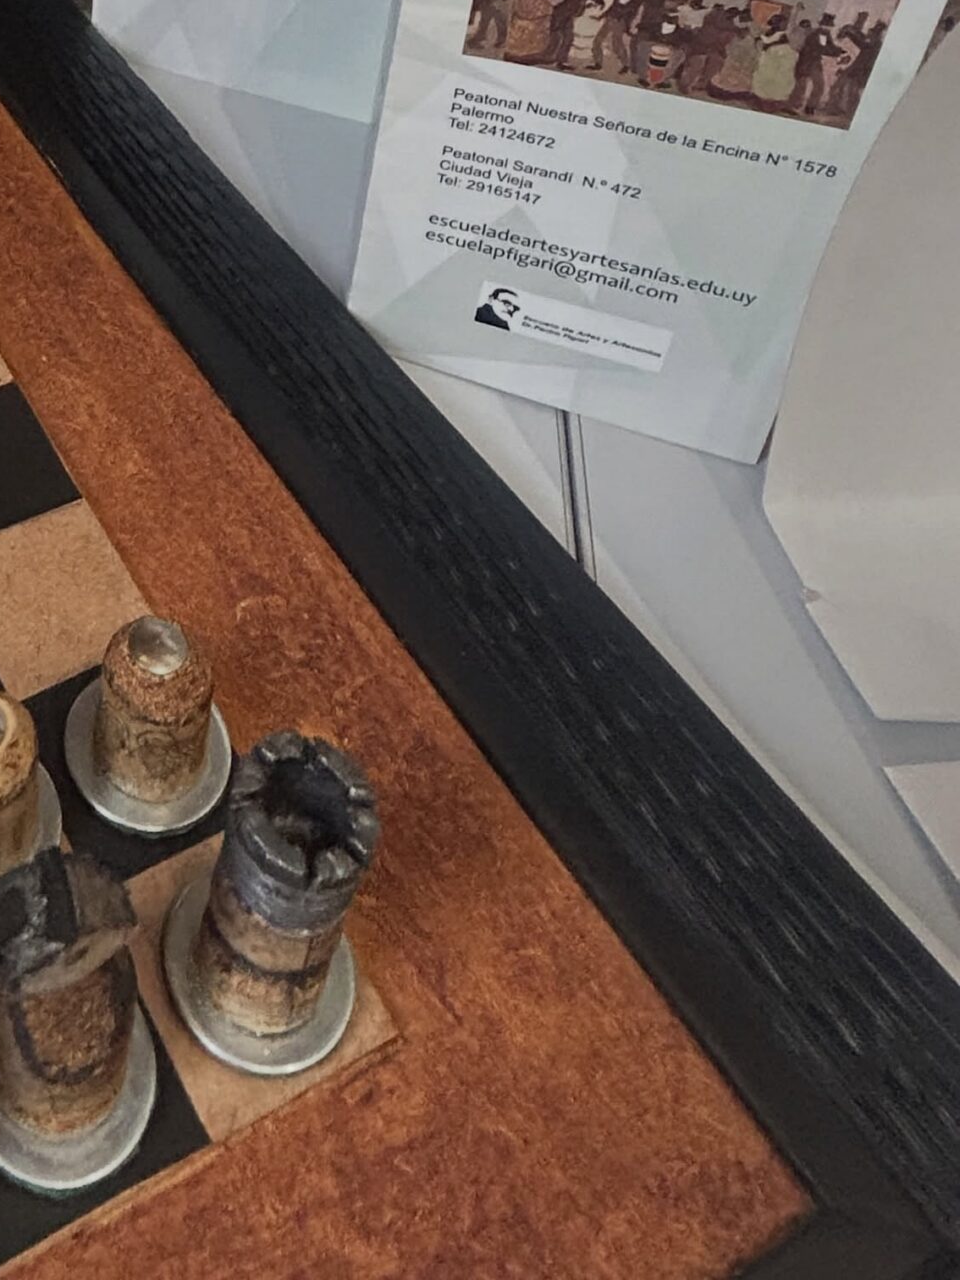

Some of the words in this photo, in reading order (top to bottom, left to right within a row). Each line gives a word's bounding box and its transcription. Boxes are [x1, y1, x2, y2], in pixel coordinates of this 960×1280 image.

[451, 102, 514, 124] Palermo
[449, 117, 473, 131] Tel:
[478, 123, 555, 149] 24124672
[452, 88, 522, 110] Peatonal
[526, 102, 588, 125] Nuestra
[593, 116, 651, 138] Señora
[657, 131, 678, 144] de
[682, 135, 697, 148] la
[702, 139, 760, 161] Encina
[796, 159, 837, 177] 1578
[438, 160, 492, 180] Ciudad
[497, 171, 533, 189] Vieja
[438, 173, 461, 186] Tel:
[466, 180, 541, 204] 29165147
[442, 145, 508, 167] Peatonal
[513, 158, 573, 184] Sarandí
[610, 183, 642, 200] 472
[426, 231, 679, 303] escuelapfigari@gmail.com
